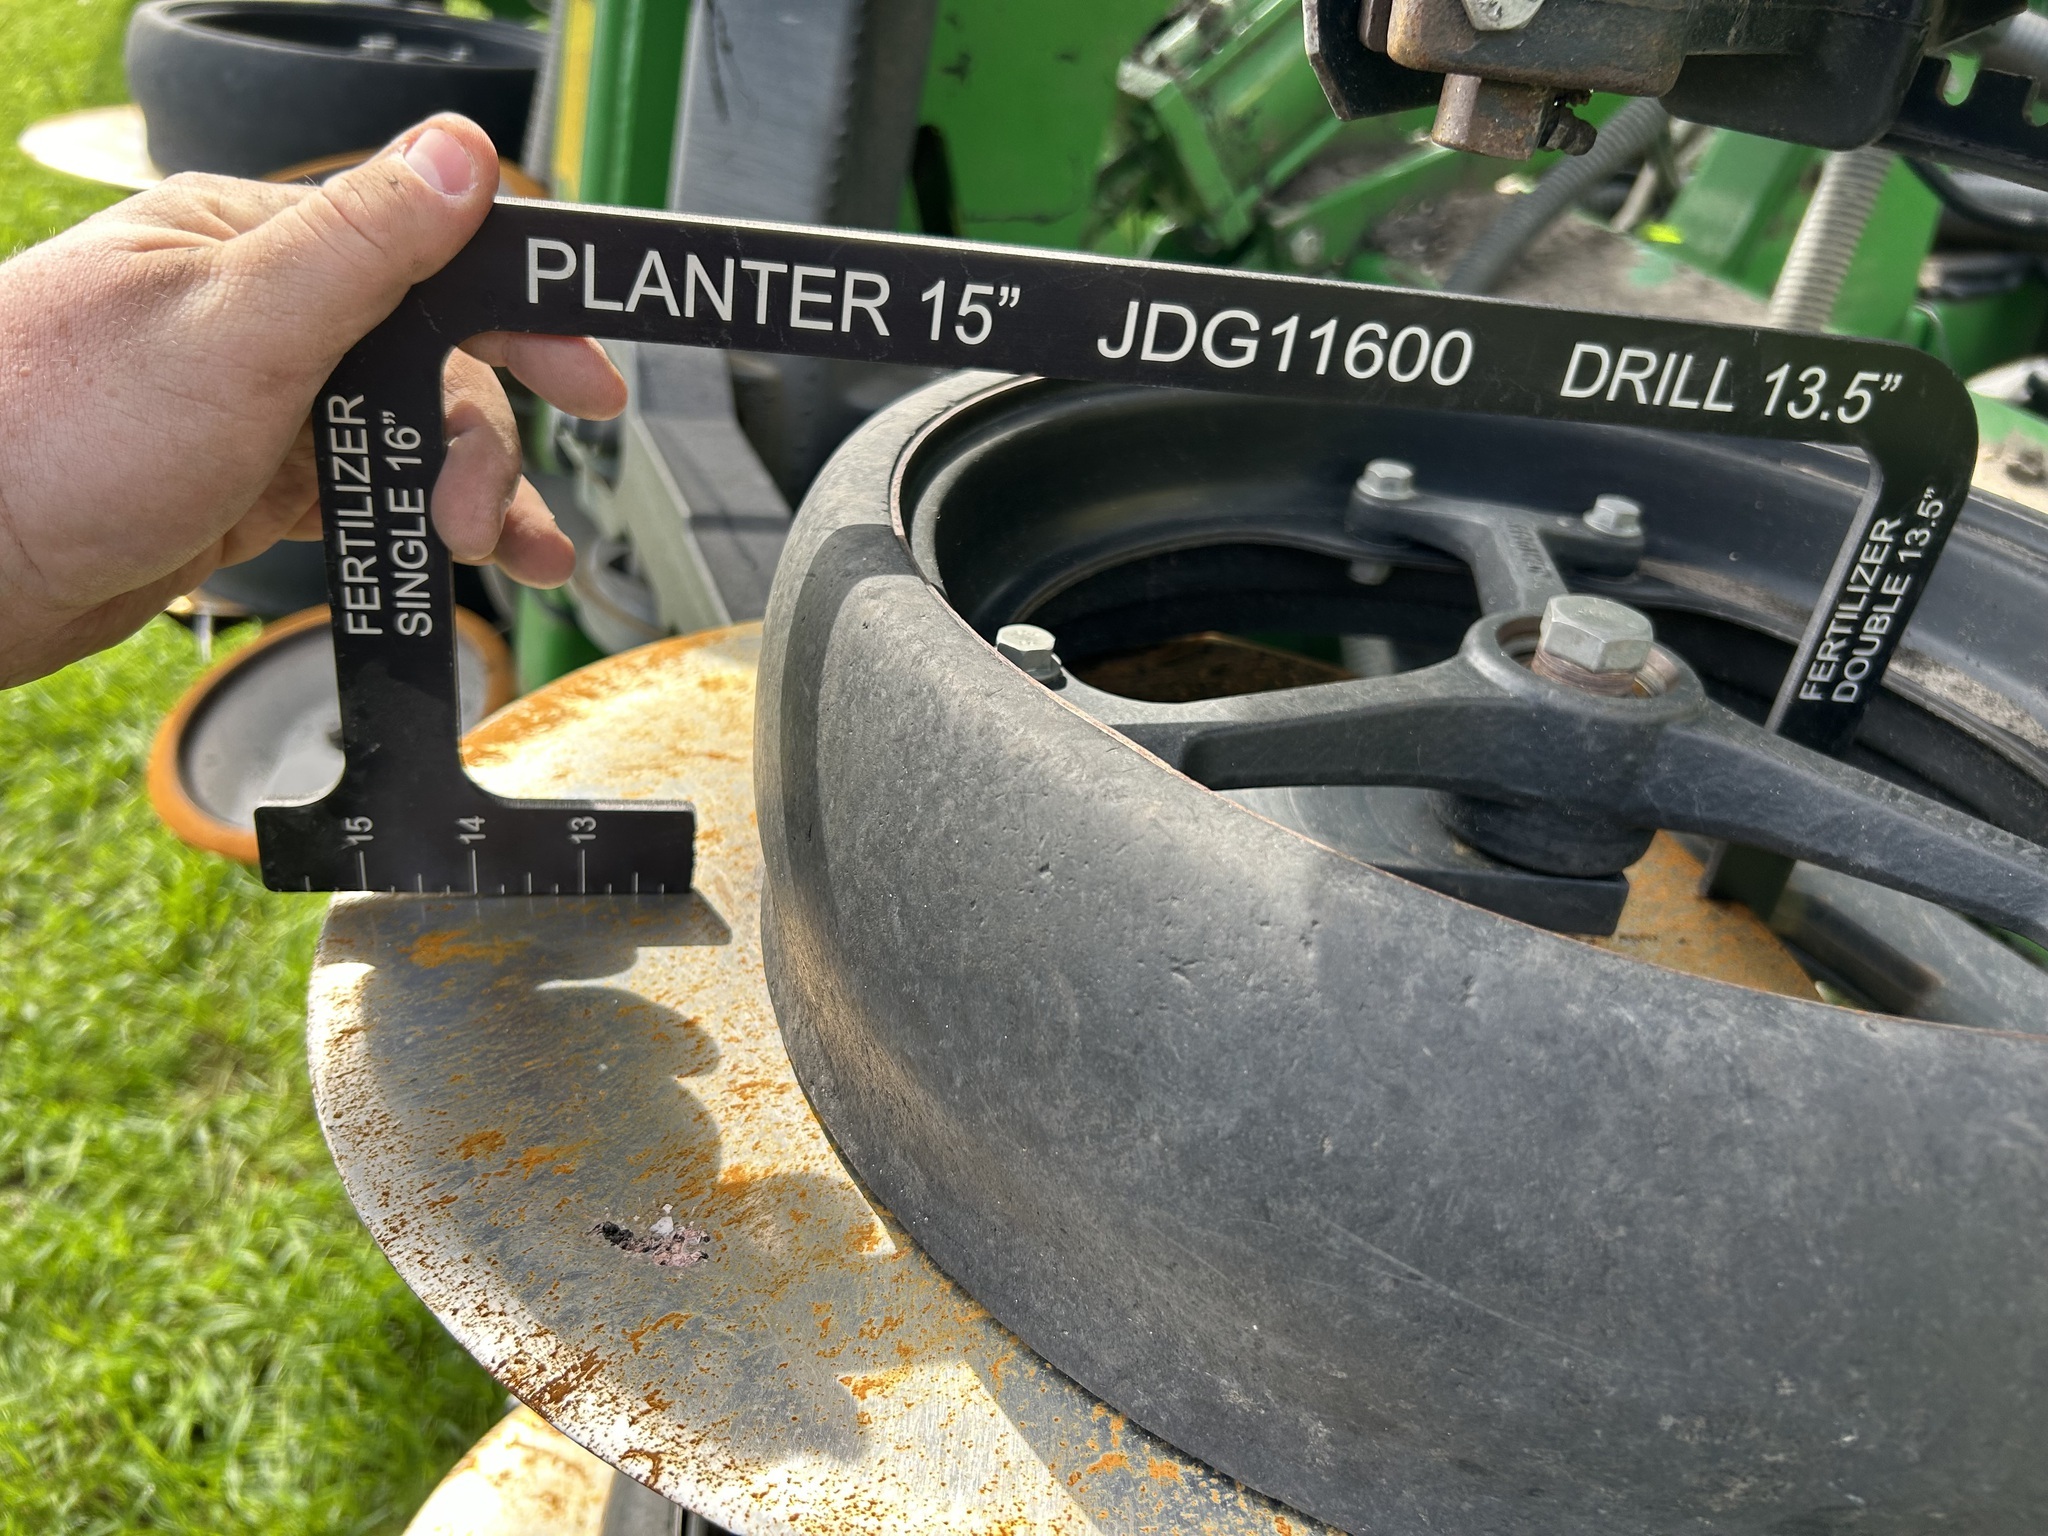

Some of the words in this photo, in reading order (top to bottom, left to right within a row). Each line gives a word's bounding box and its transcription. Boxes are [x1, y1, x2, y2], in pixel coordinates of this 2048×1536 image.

[526, 237, 891, 337] PLANTER
[1097, 300, 1474, 387] JDG11600
[1559, 341, 1735, 414] DRILL
[327, 394, 384, 636] FERTILIZER
[386, 488, 433, 637] SINGLE
[1799, 516, 1903, 702] FERTILIZER
[1832, 573, 1911, 704] DOUBLE
[345, 815, 374, 846] 15
[456, 815, 486, 844] 14
[567, 816, 597, 844] 13
